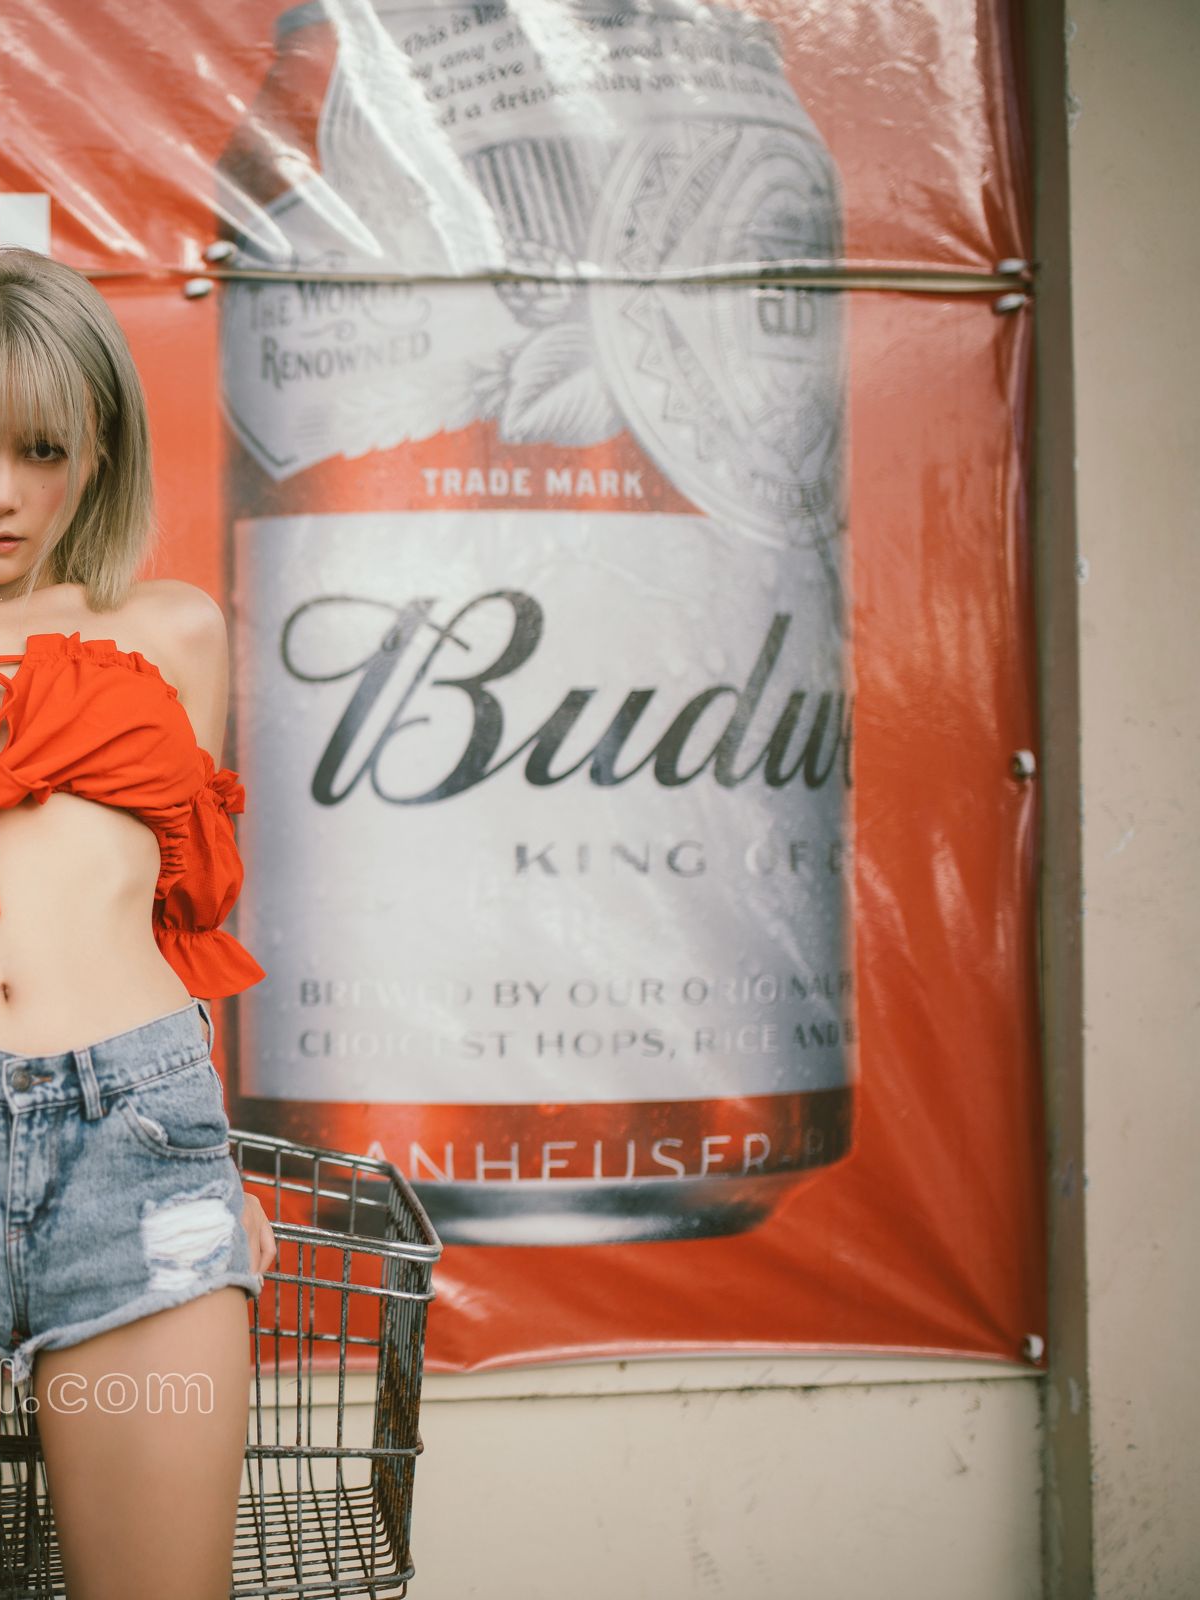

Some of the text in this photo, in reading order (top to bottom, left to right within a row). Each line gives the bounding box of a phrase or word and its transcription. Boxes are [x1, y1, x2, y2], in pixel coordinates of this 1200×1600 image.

[260, 330, 433, 391] RENOWNED
[420, 467, 644, 499] TRADE MARK
[281, 588, 855, 807] Budw
[513, 840, 707, 878] KING
[494, 978, 551, 1009] BY
[568, 977, 665, 1008] OUR
[537, 1027, 677, 1060] HOPS,
[694, 1023, 779, 1056] RICE
